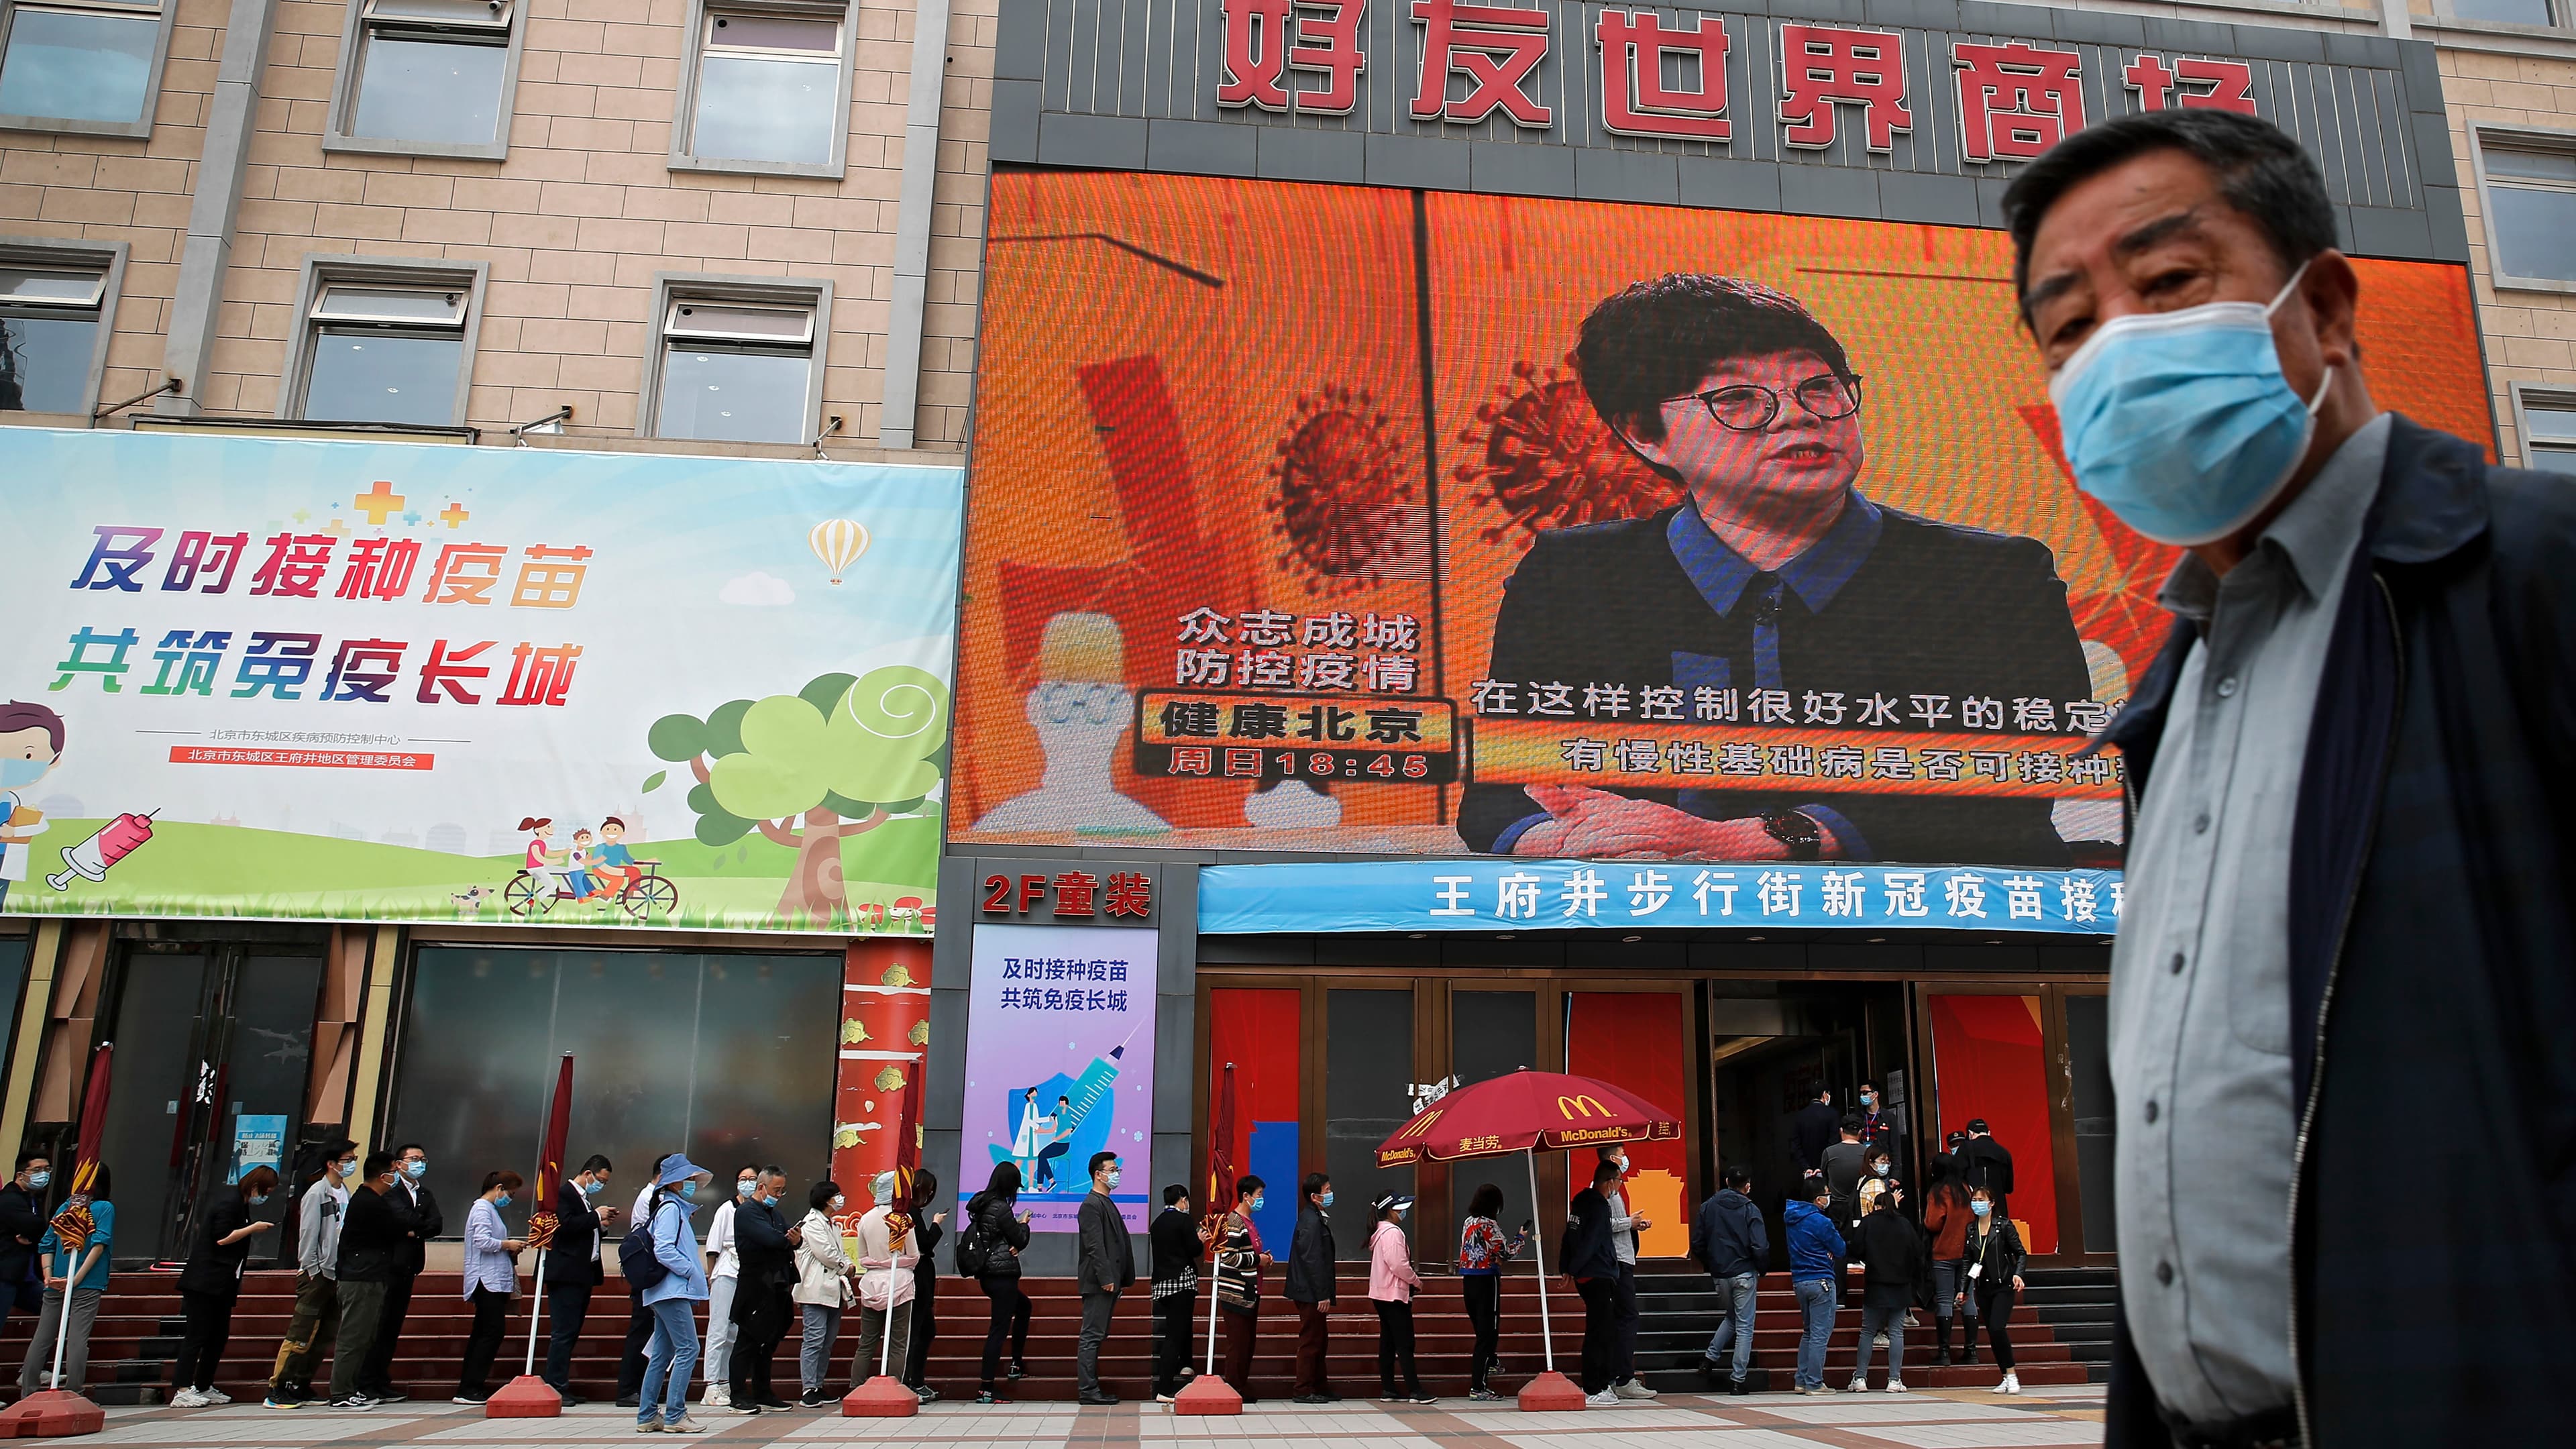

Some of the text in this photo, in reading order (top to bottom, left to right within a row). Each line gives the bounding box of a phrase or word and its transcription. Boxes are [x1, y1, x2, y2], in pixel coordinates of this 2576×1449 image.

[70, 525, 594, 609] 及时接种疫苗
[1176, 606, 1421, 651] 众志成城
[48, 626, 584, 707] 共筑免疫长城
[1175, 649, 1420, 692] 防控疫情
[1160, 700, 1423, 743] 健康北京
[1470, 678, 2129, 733] 在这样控制很好水平的稳定
[187, 749, 417, 767] 北京市东城区王府井地区管理委员会
[209, 729, 401, 745] 北京市东城区疾病预防控制中心
[1560, 737, 2125, 786] 有慢性基础病是否可接种
[1002, 958, 1129, 982] 及时接种疫苗
[1000, 987, 1128, 1012] 共筑免疫长城
[1460, 1135, 1499, 1152] 麦当劳
[1561, 1127, 1628, 1142] McDonald's
